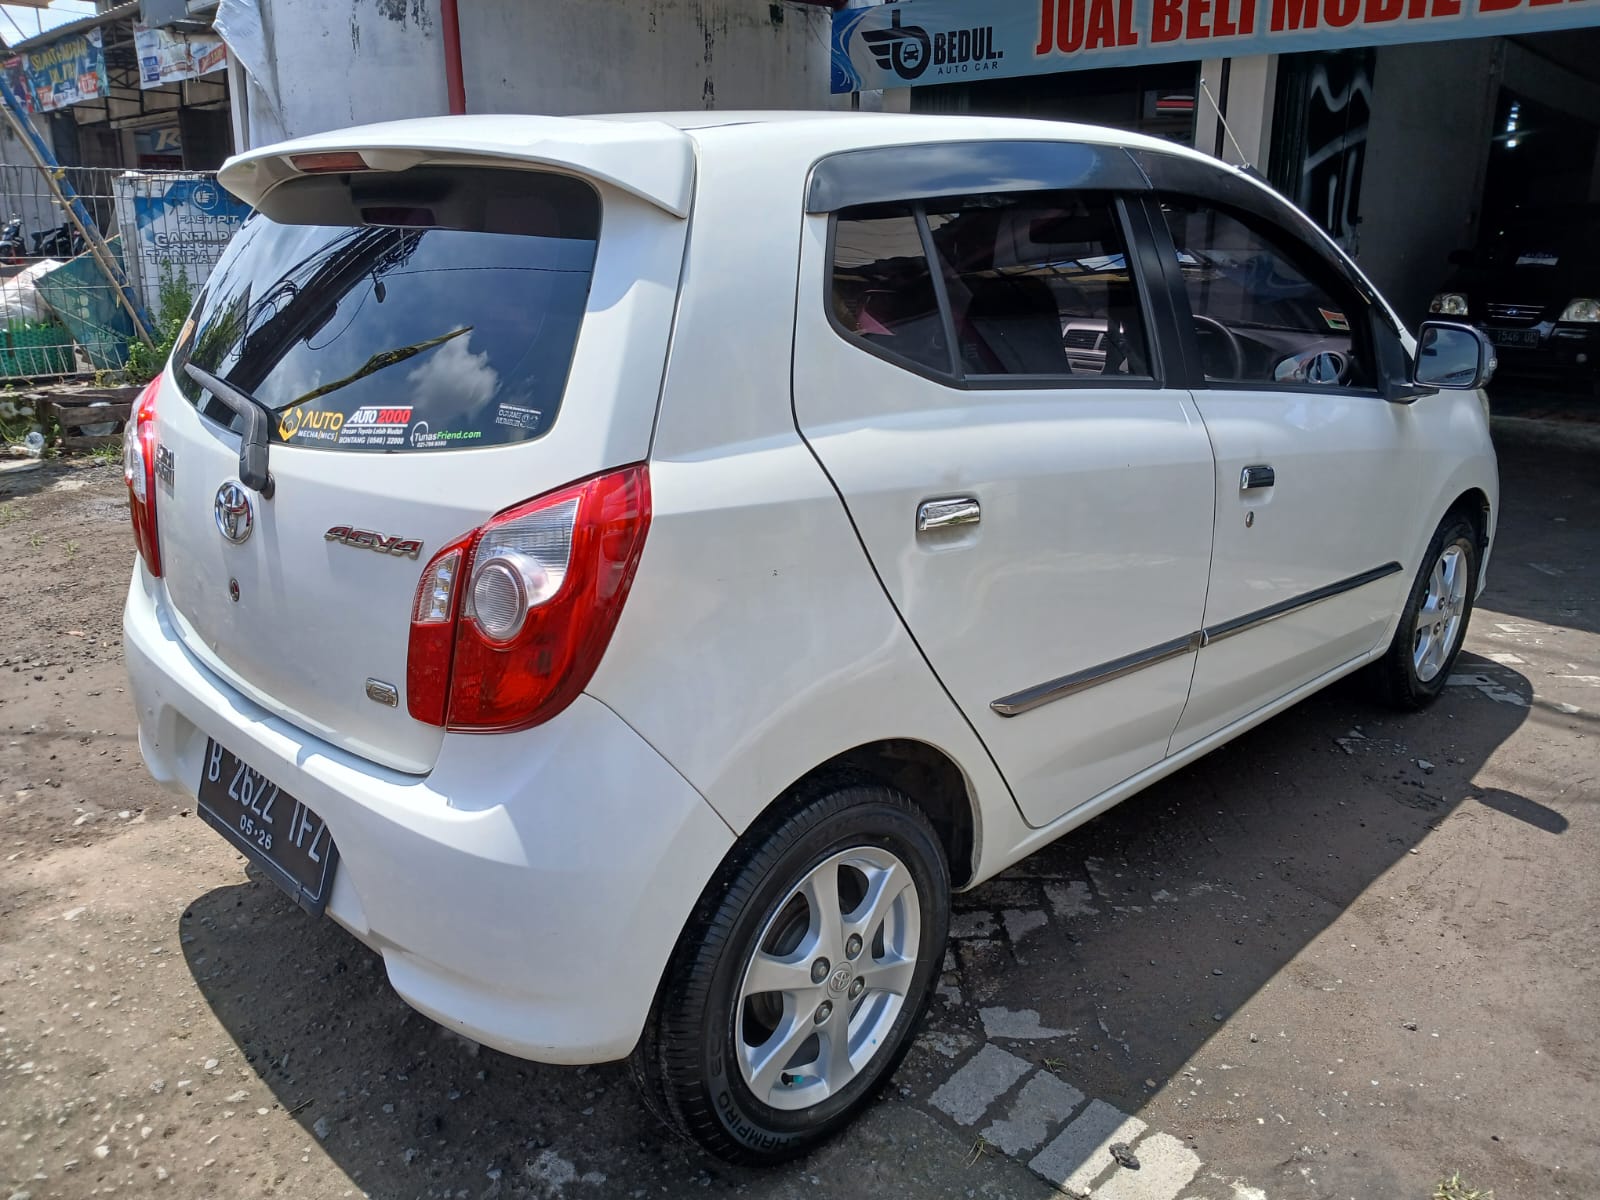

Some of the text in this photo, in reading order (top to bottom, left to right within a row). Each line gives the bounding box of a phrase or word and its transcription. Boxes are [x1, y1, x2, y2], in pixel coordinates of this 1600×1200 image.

[1036, 0, 1138, 55] JUAL
[937, 61, 999, 75] AUTO CAR
[302, 410, 344, 431] AUTO
[414, 430, 482, 442] TunasFriend.com
[208, 741, 223, 783] B
